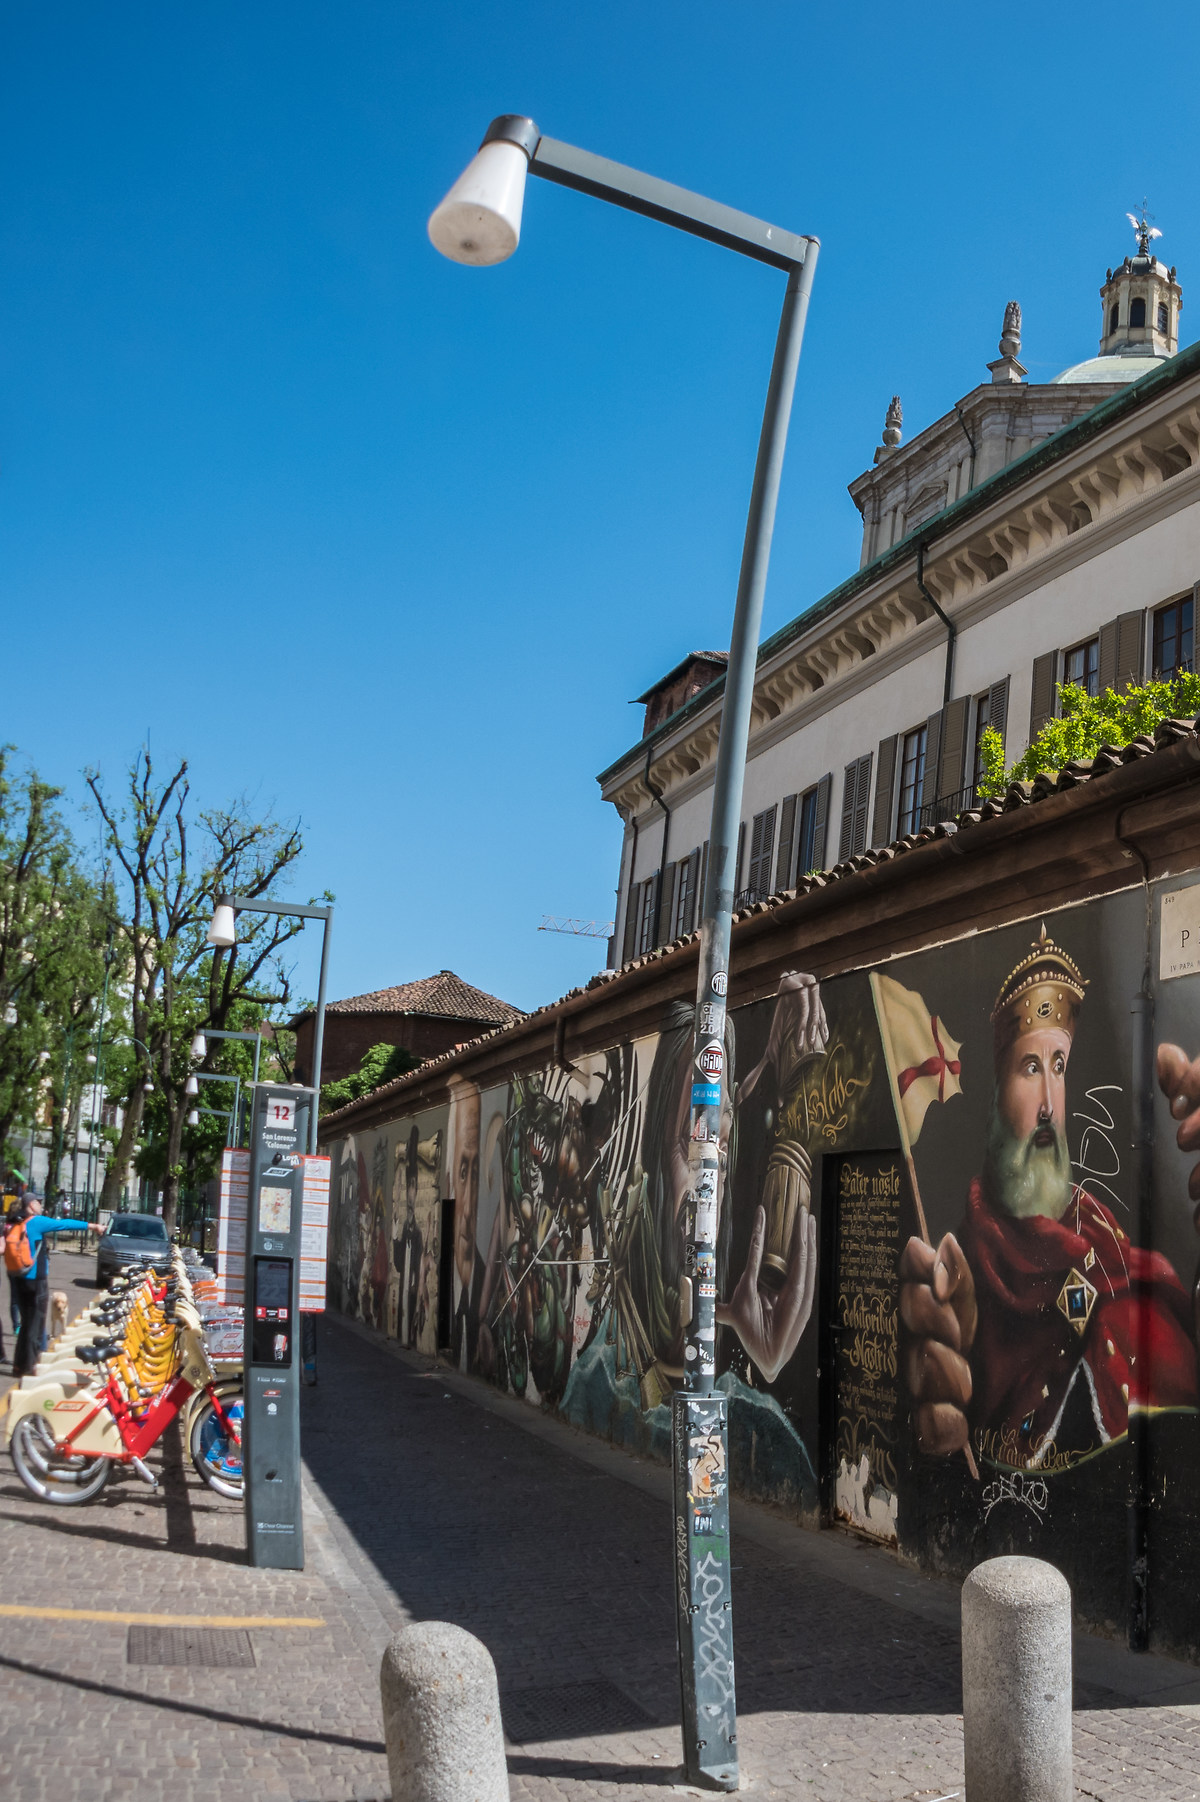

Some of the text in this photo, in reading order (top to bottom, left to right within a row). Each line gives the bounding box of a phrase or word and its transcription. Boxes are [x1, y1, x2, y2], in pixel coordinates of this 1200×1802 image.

[1170, 964, 1177, 973] IV
[1179, 961, 1194, 971] PAPA
[273, 1105, 290, 1120] 12
[262, 1132, 297, 1142] San Lorenzo
